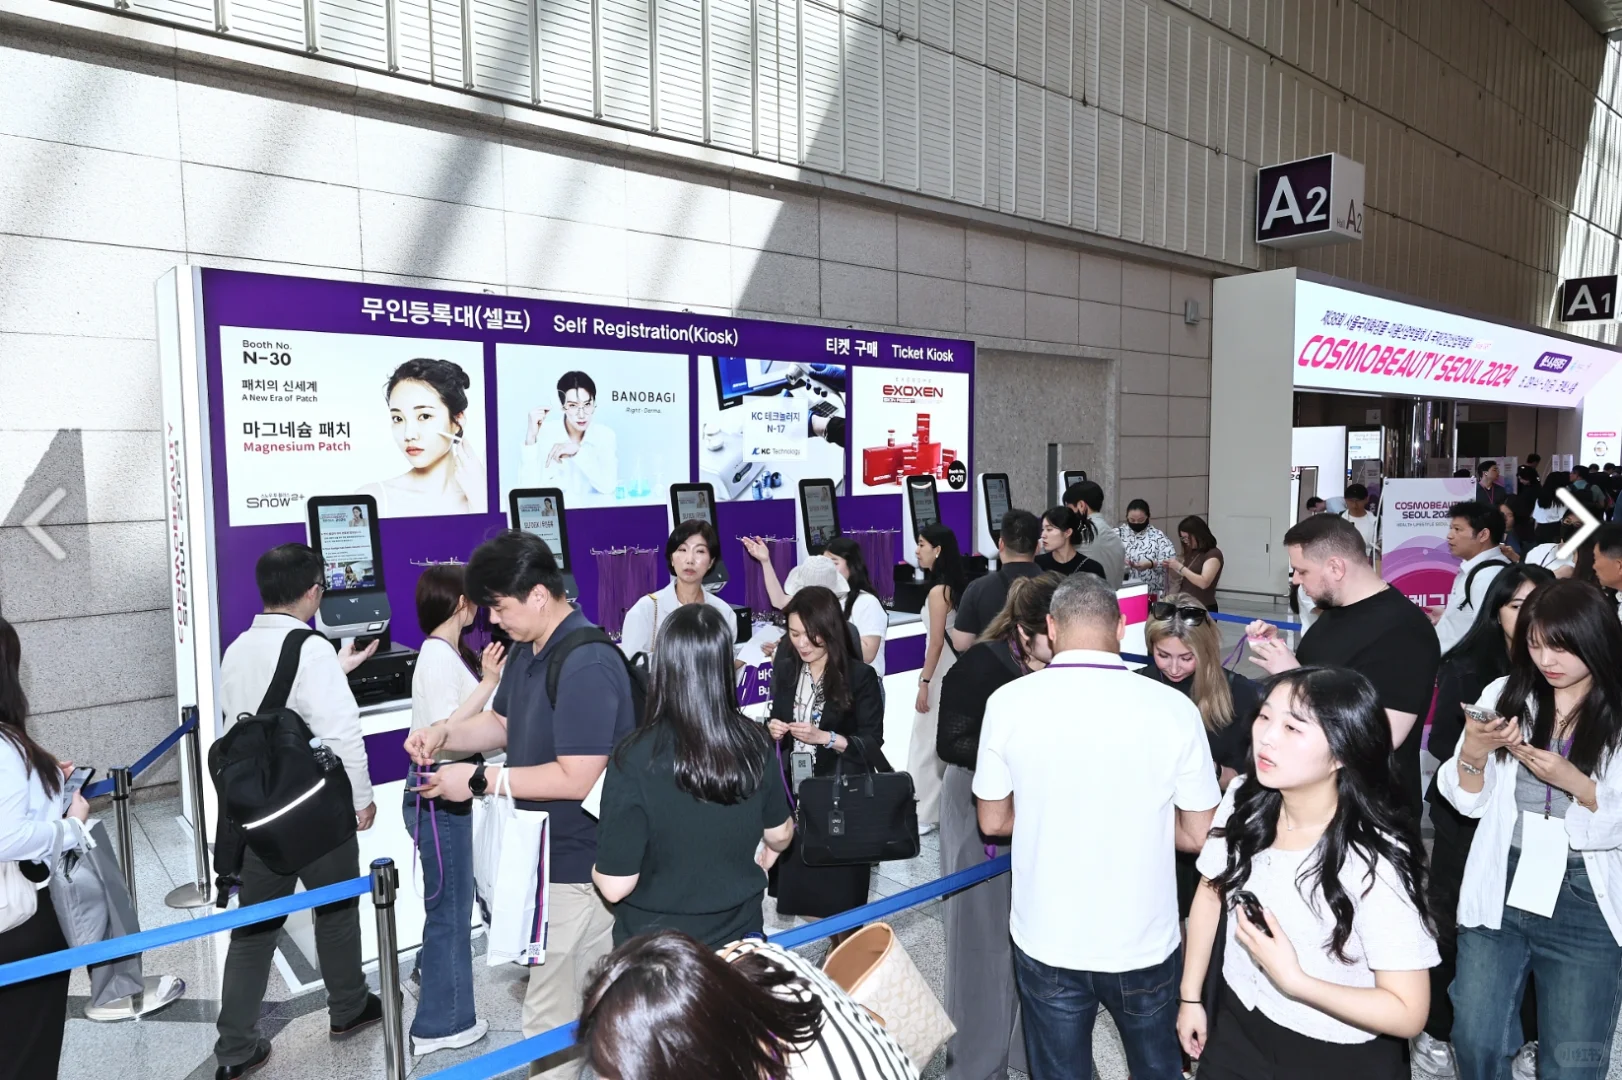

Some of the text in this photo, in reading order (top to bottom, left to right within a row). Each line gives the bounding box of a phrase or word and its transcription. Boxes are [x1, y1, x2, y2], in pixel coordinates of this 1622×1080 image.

[1261, 175, 1327, 230] A2
[1346, 199, 1363, 233] A2
[1566, 284, 1611, 315] A1
[361, 297, 531, 332] 무인등록대(셀프)
[553, 315, 739, 347] Self Registration(Kiosk)
[242, 340, 292, 351] Booth No.
[825, 337, 879, 359] 티켓 구매
[243, 351, 292, 366] N-30
[892, 344, 954, 362] Ticket Kiosk
[1297, 334, 1445, 379] COSMOBEAUTY
[1433, 355, 1484, 385] SEOUL
[1476, 361, 1519, 388] 2024
[242, 379, 318, 393] 패치의 신세계
[883, 384, 944, 398] EXOXEN
[284, 394, 293, 402] of
[296, 395, 318, 403] Patch
[612, 390, 676, 403] BANOBAGI
[751, 411, 763, 421] KC
[243, 421, 351, 439] 마그네슘 패치
[767, 424, 786, 433] N-17
[243, 441, 351, 455] Magnesium Patch
[772, 448, 801, 456] Technology
[1395, 502, 1462, 510] COSMOBEAU
[1402, 510, 1452, 519] SEOUL 202
[168, 421, 184, 644] COSMOBEAUTY
[179, 531, 189, 627] SEOUL
[758, 685, 770, 696] Bu
